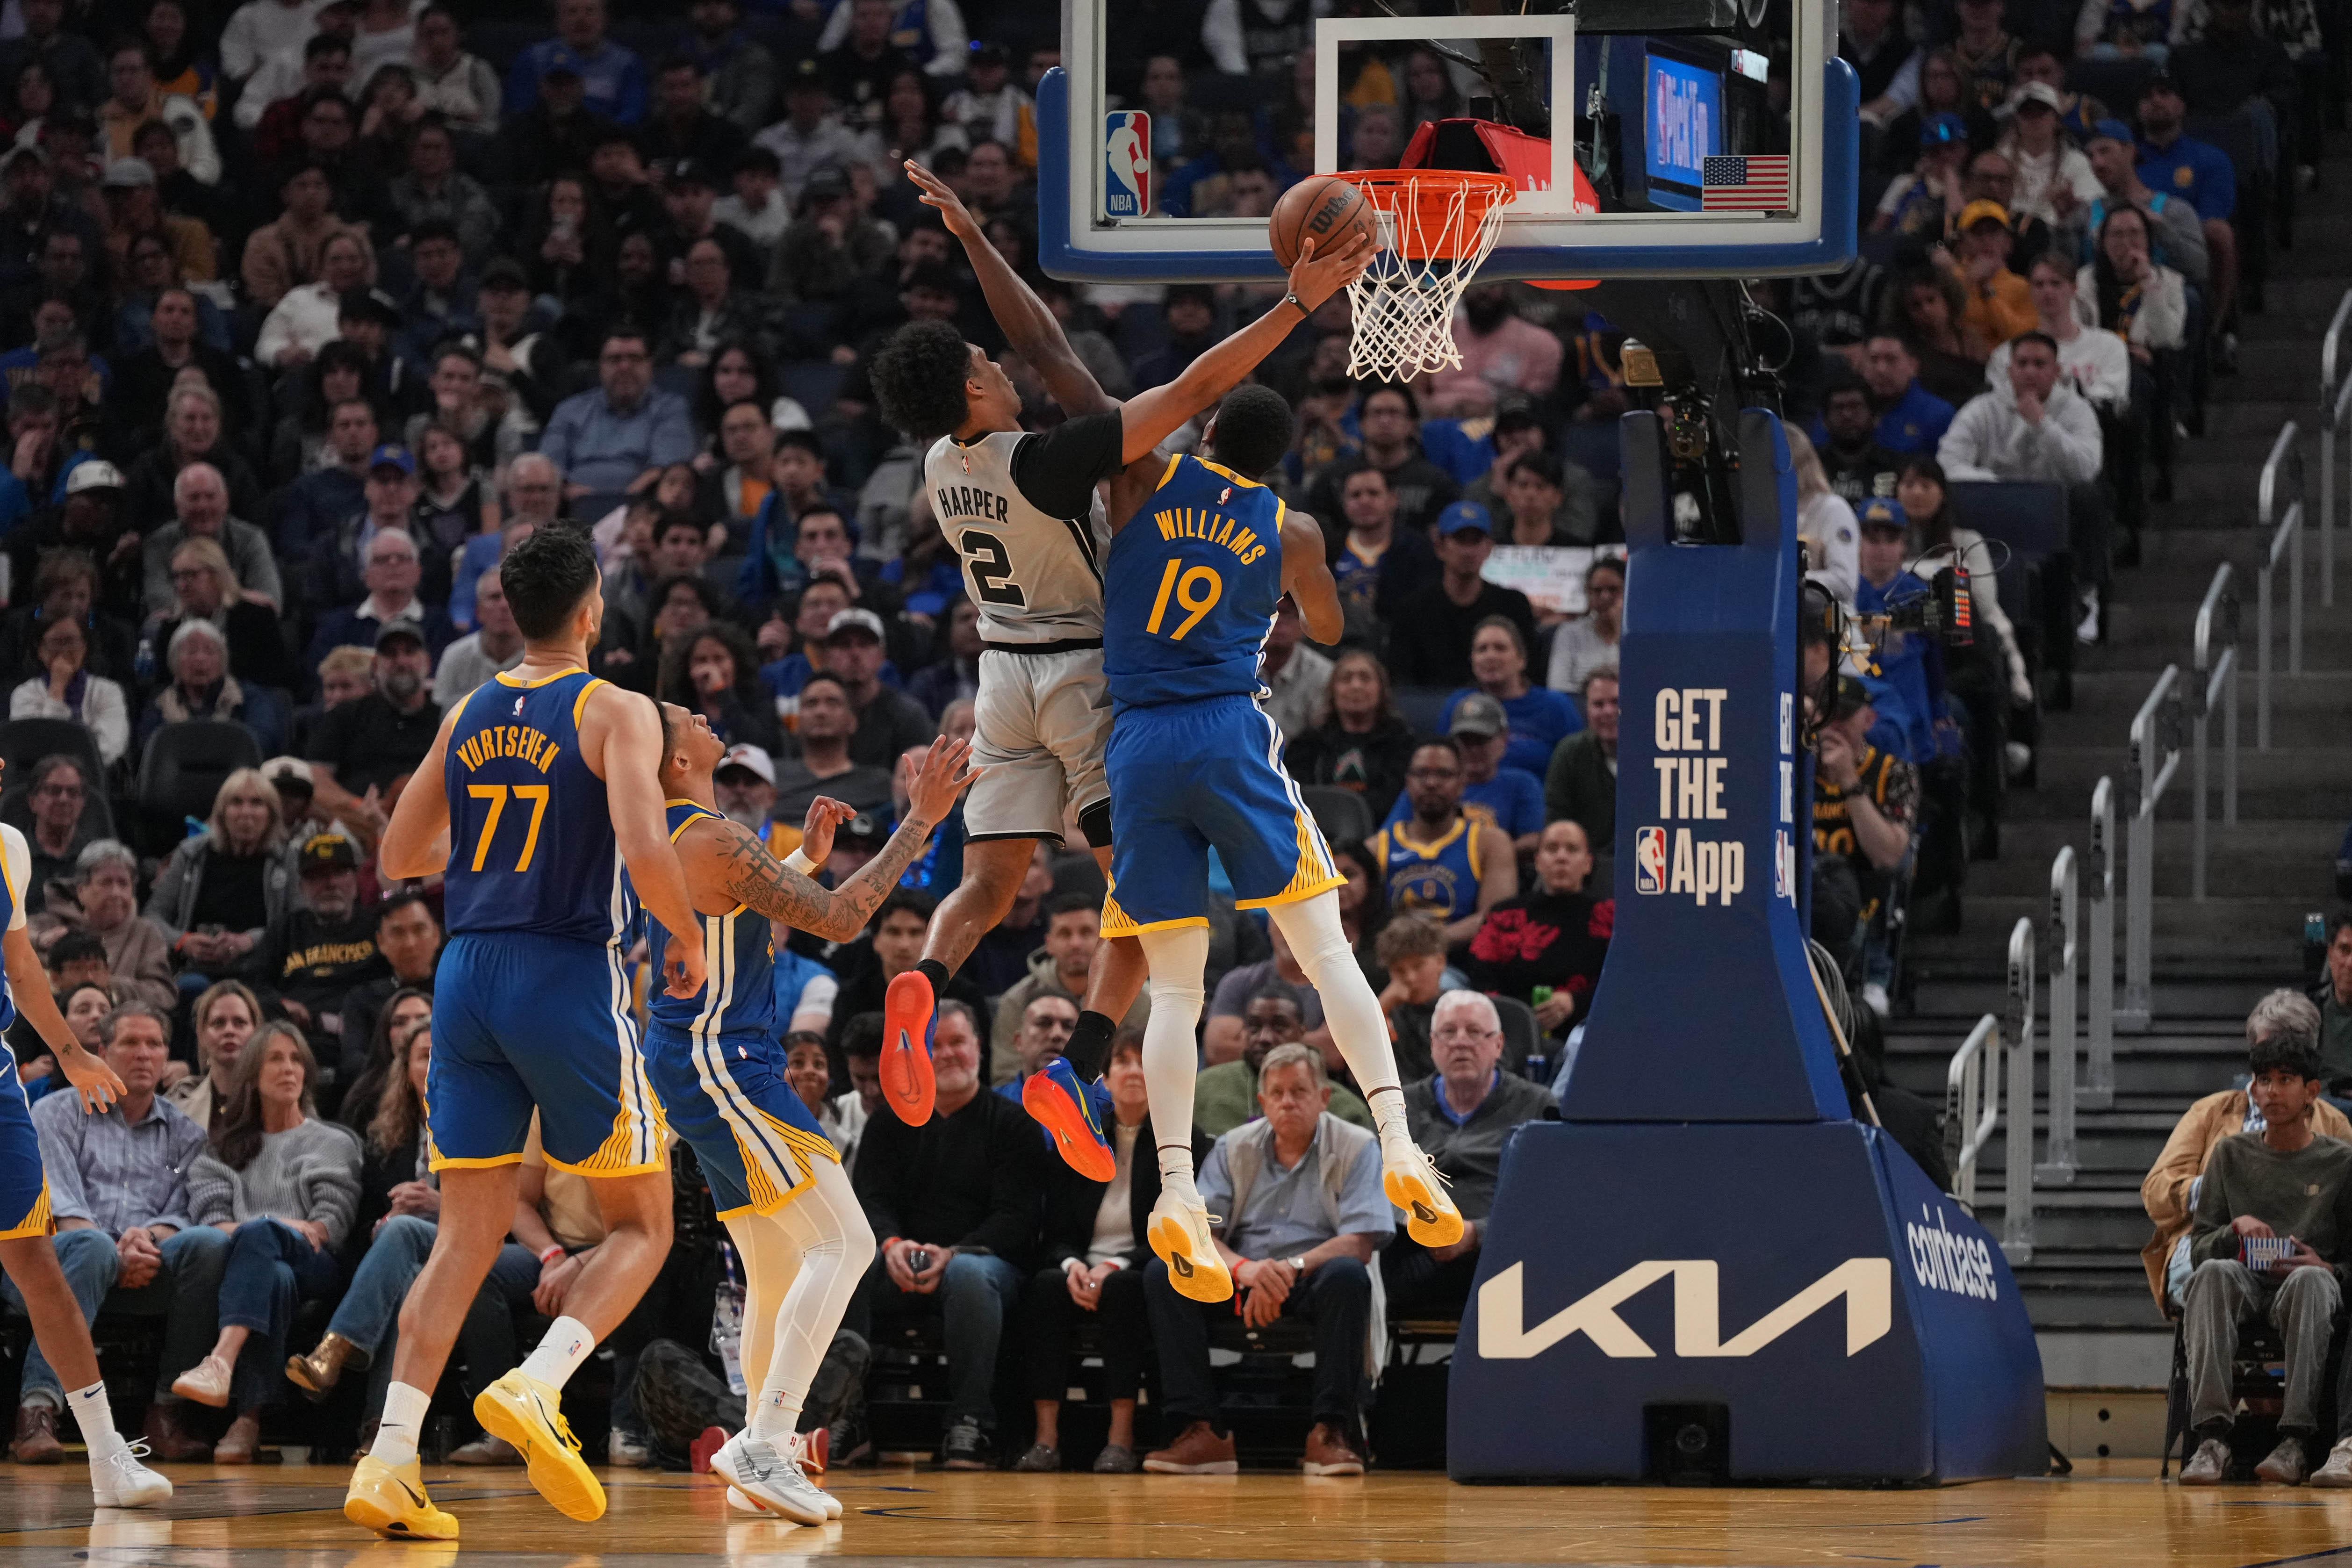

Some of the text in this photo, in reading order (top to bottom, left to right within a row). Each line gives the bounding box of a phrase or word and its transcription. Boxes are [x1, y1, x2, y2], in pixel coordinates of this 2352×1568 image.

[1110, 194, 1132, 211] NBA
[937, 486, 1008, 524] HARPER
[1154, 508, 1266, 566] WILLIAMS
[959, 528, 1027, 610] 2
[1145, 558, 1223, 640] 19
[456, 726, 561, 774] YURTSEVEN
[1655, 688, 1728, 751] GET
[1654, 757, 1728, 820] THE
[467, 784, 550, 872] 77
[1670, 828, 1744, 906] App
[305, 940, 373, 967] FRANCISCO
[1907, 1202, 1997, 1302] coinbase
[1478, 1257, 1892, 1359] KIA
